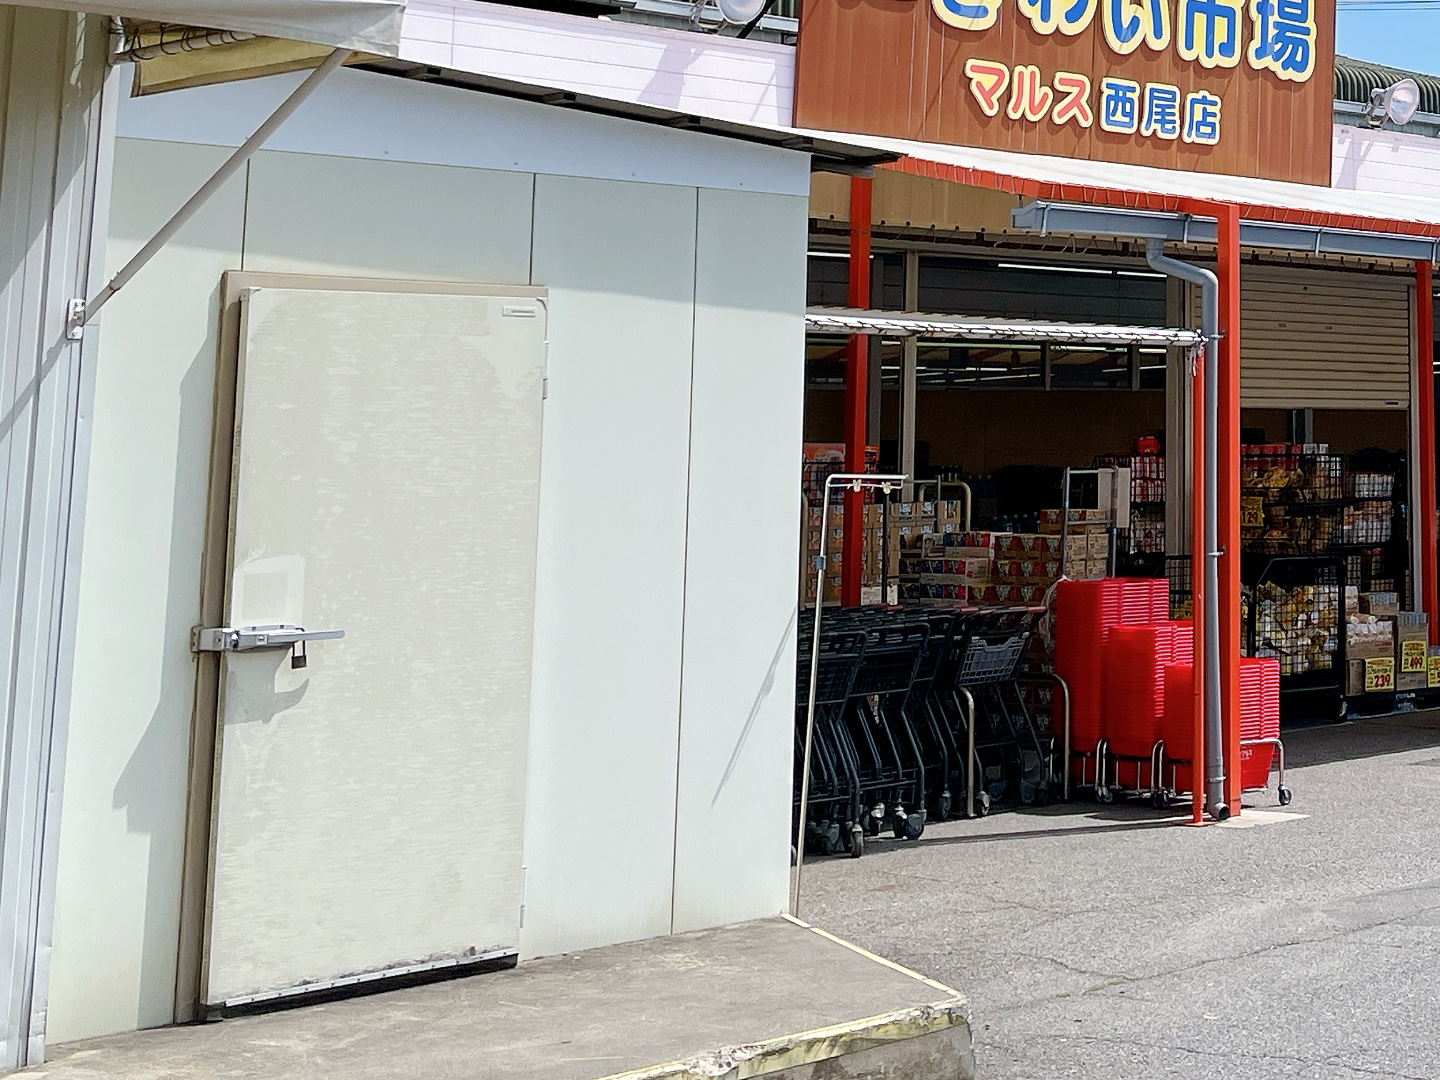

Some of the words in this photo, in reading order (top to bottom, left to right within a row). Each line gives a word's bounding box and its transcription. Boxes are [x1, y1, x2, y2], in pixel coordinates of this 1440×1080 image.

[965, 58, 1222, 145] マルス西尾店
